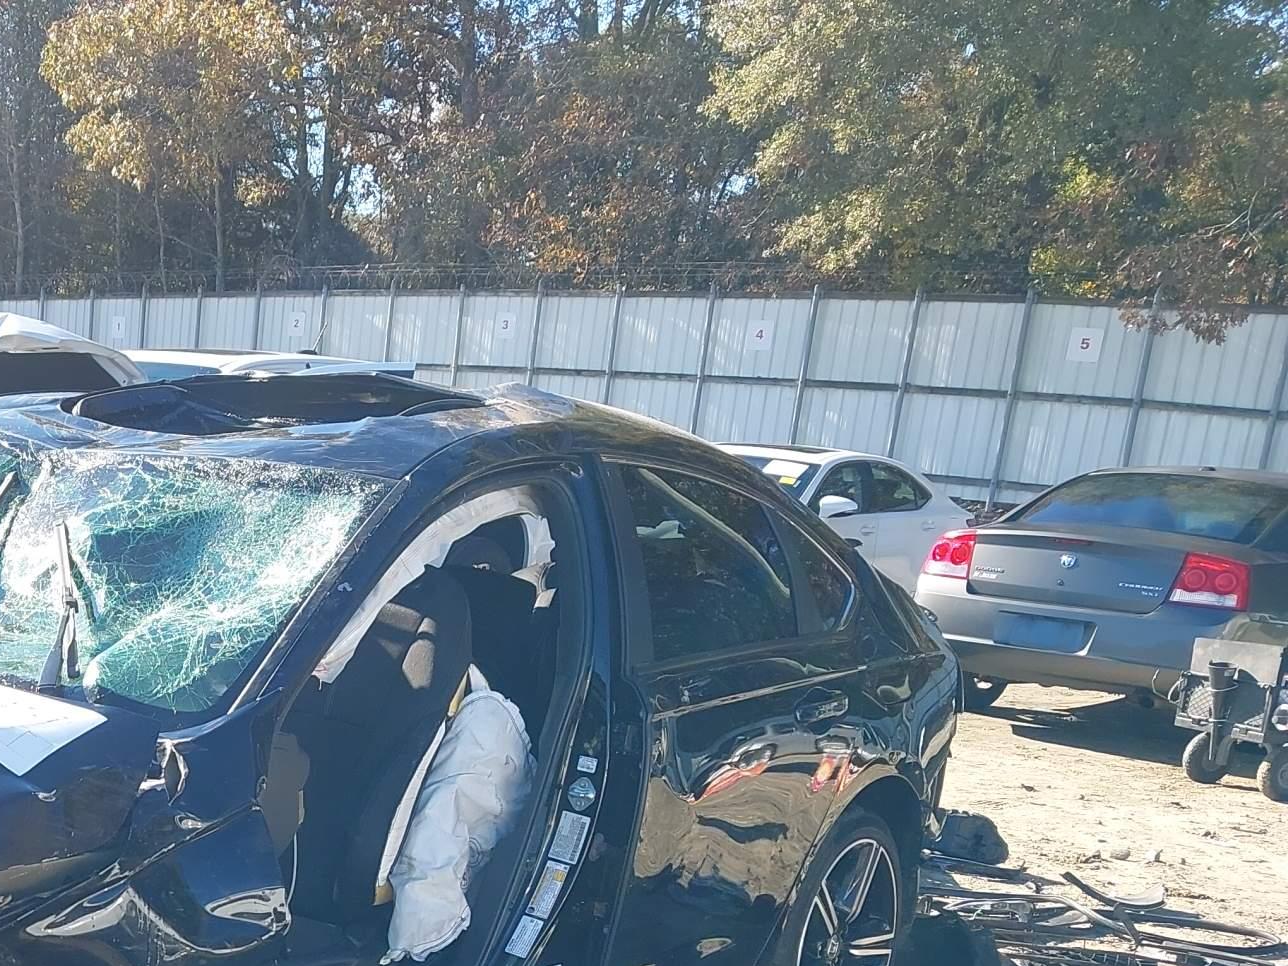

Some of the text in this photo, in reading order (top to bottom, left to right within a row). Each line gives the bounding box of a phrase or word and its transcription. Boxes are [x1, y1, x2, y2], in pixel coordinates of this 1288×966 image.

[500, 319, 509, 330] 3
[754, 328, 765, 340] 4
[1079, 337, 1091, 350] 5
